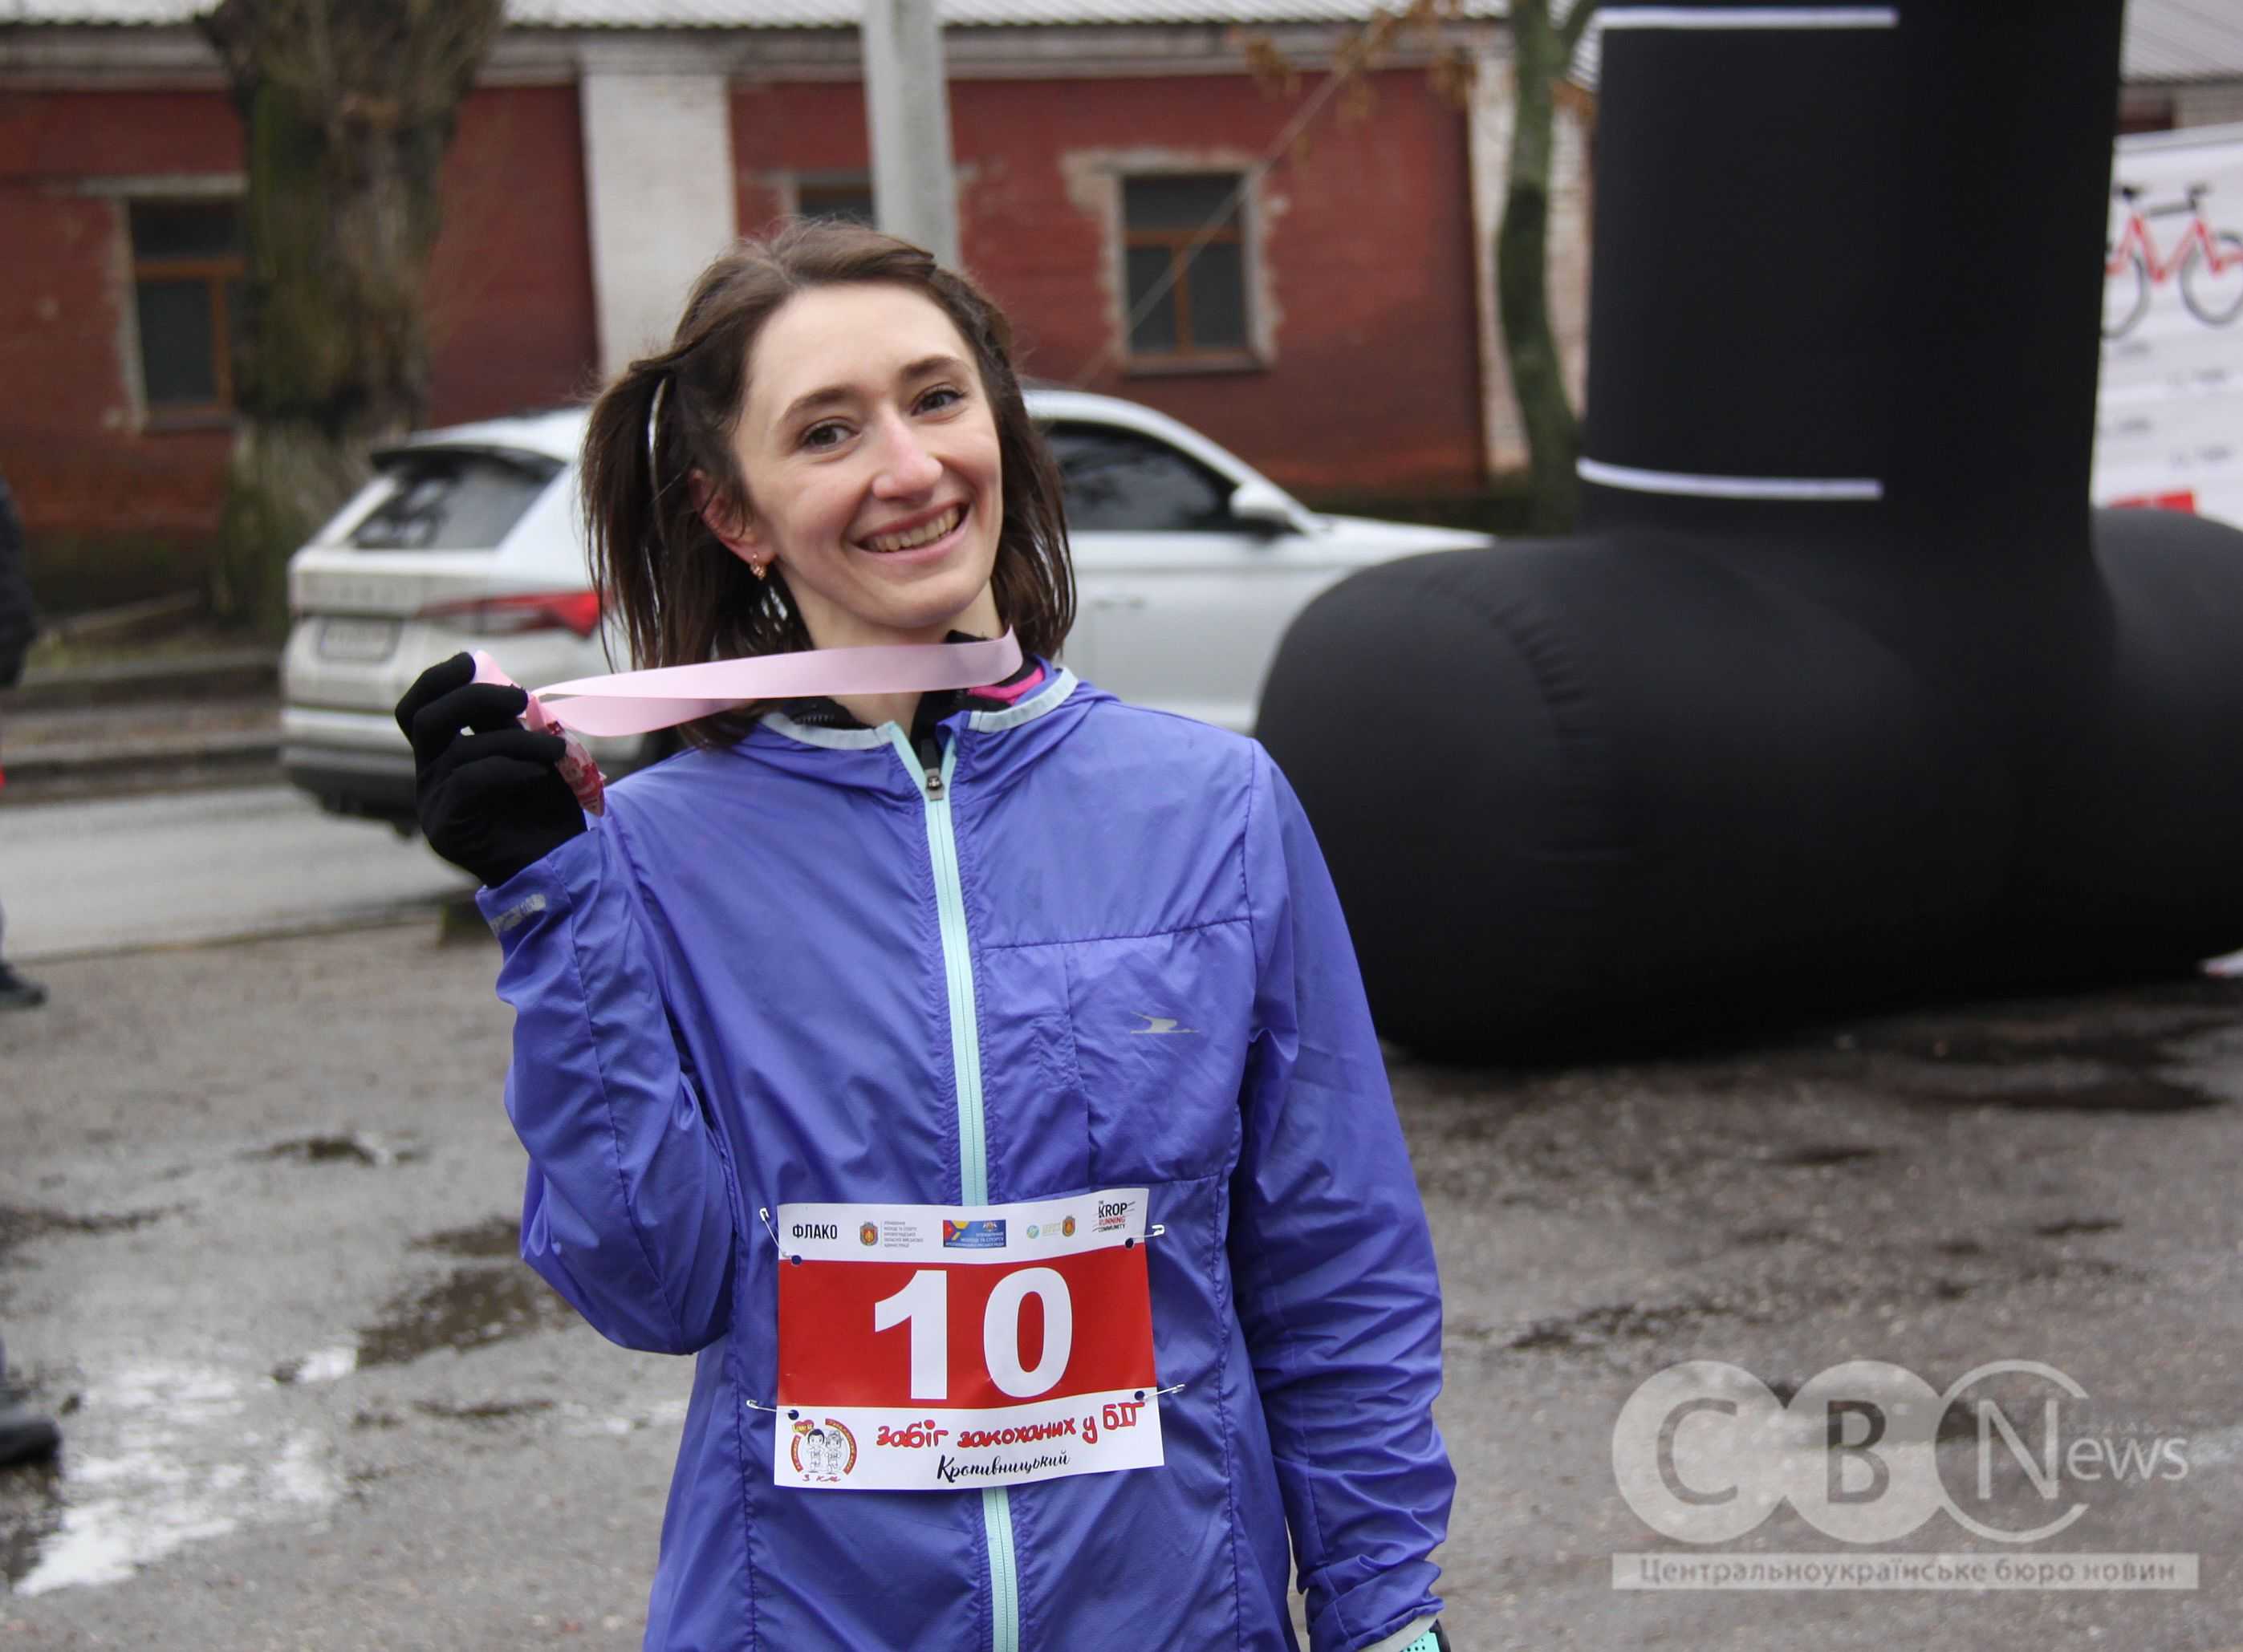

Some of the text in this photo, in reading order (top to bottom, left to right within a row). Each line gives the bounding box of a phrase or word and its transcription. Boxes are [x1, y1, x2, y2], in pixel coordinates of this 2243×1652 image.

[1099, 1203, 1128, 1218] KROP
[793, 1224, 838, 1240] ФЛАКО
[875, 1267, 1073, 1400] 10
[957, 1418, 1076, 1447] закоханих
[1083, 1416, 1098, 1443] у
[937, 1449, 1071, 1484] Кропивницький
